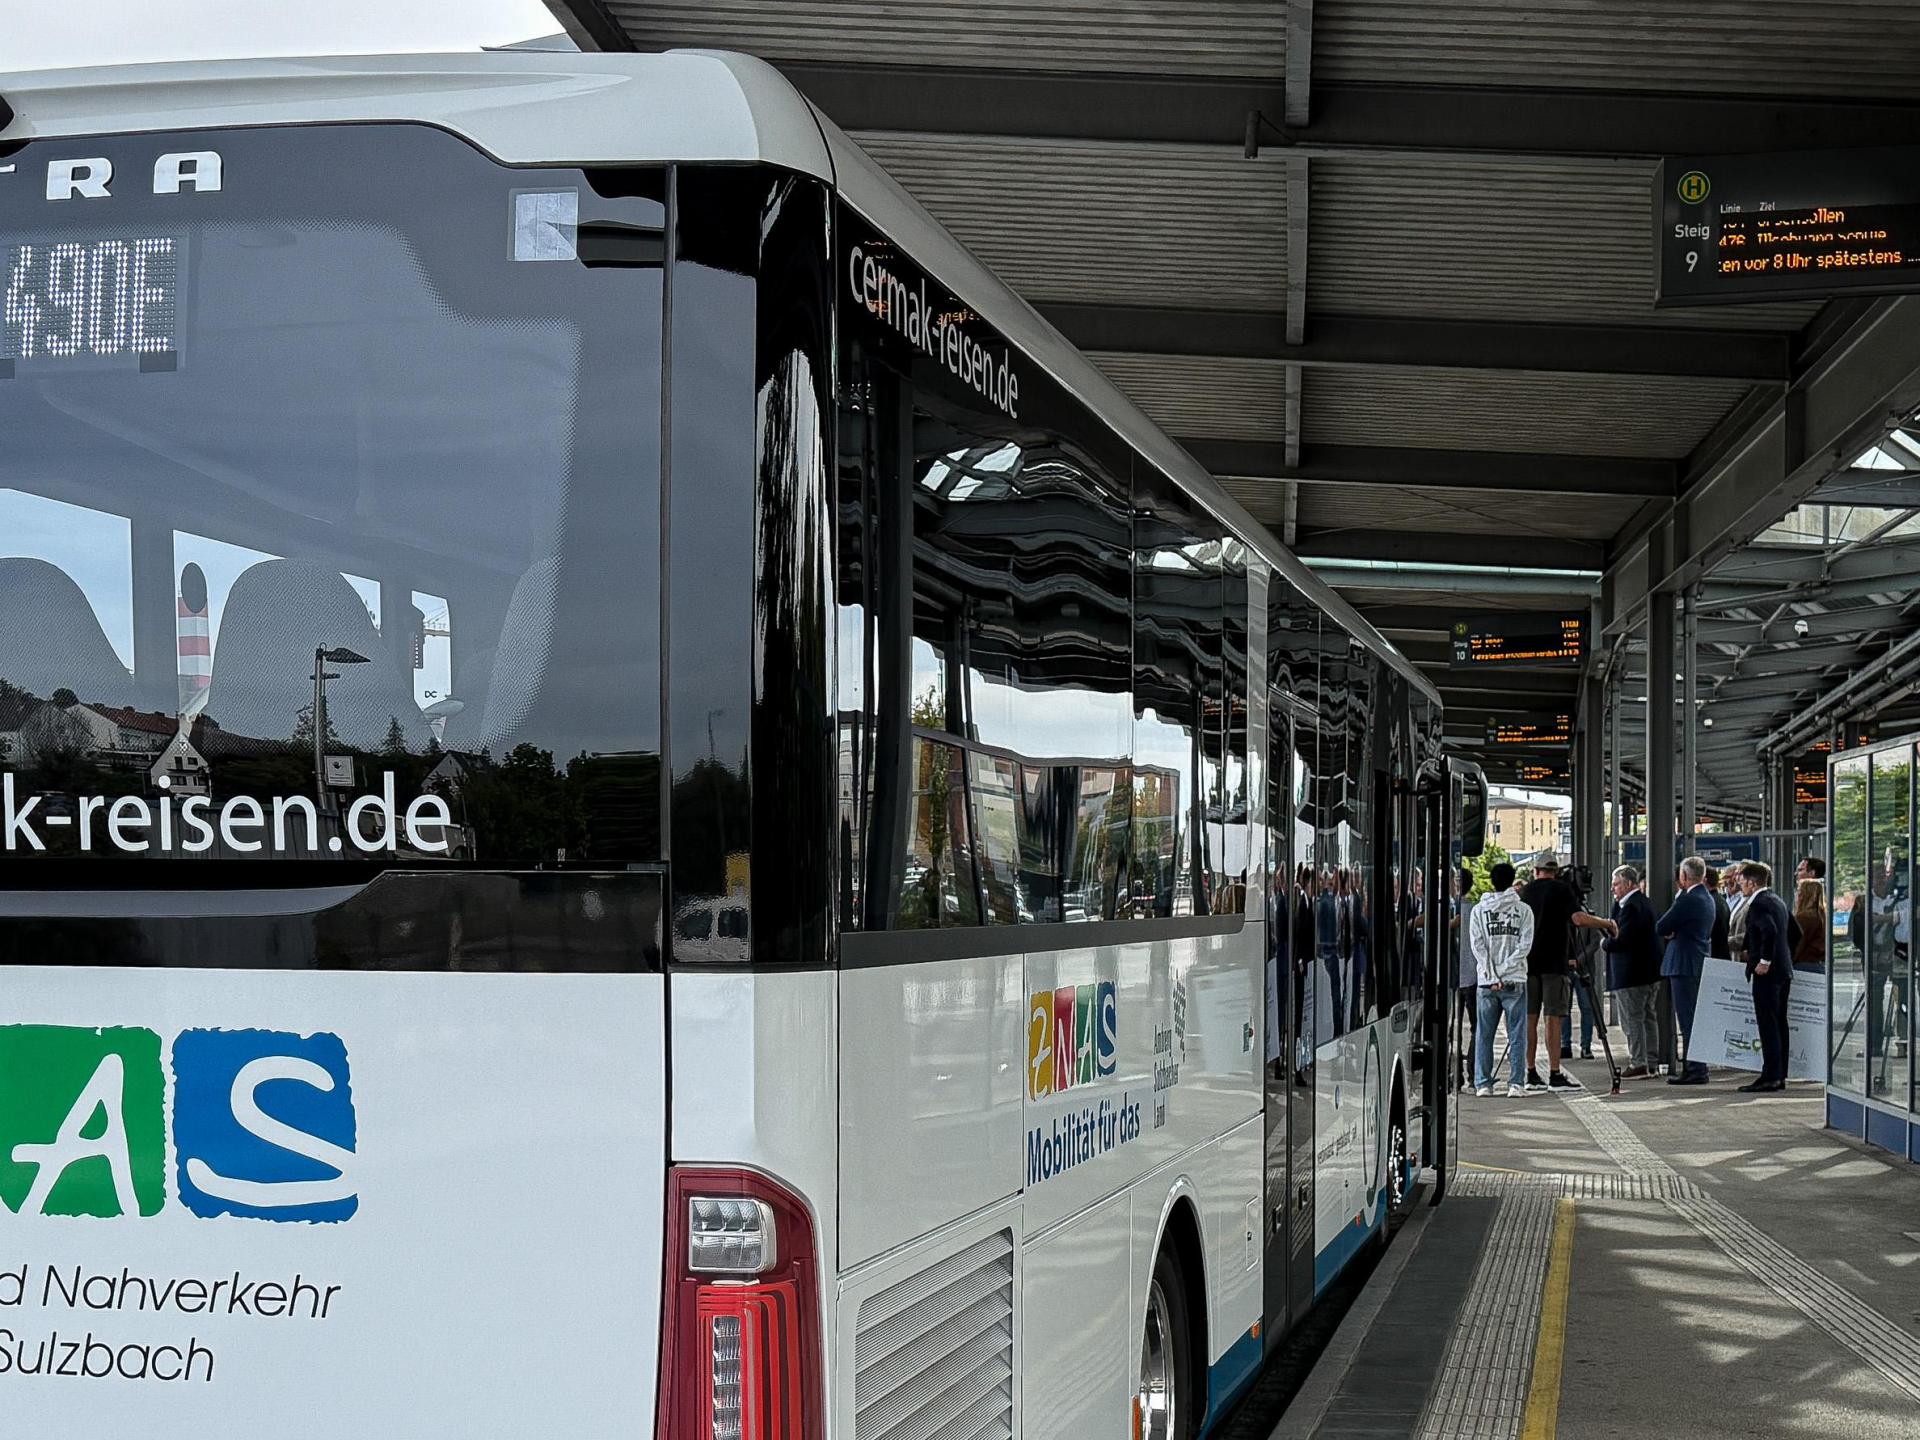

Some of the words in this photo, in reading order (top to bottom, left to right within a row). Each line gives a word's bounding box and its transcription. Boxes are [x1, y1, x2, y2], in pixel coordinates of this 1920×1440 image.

[0, 151, 222, 200] RA
[1720, 203, 1741, 214] Linie
[1759, 201, 1776, 211] Ziel
[1674, 224, 1710, 240] Steig
[1685, 251, 1698, 273] 9
[1718, 260, 1740, 273] en
[1744, 258, 1769, 271] vor
[1773, 253, 1783, 269] 8
[1786, 253, 1812, 268] Uhr
[1816, 249, 1903, 269] spätestens
[849, 246, 1019, 419] cermak-reisen.de
[1456, 651, 1466, 660] 10
[4, 772, 451, 852] k-reisen.de
[1028, 1108, 1096, 1187] Mobilität
[1098, 1099, 1117, 1155] für
[1119, 1092, 1141, 1146] das
[42, 1264, 342, 1319] Nahverkehr
